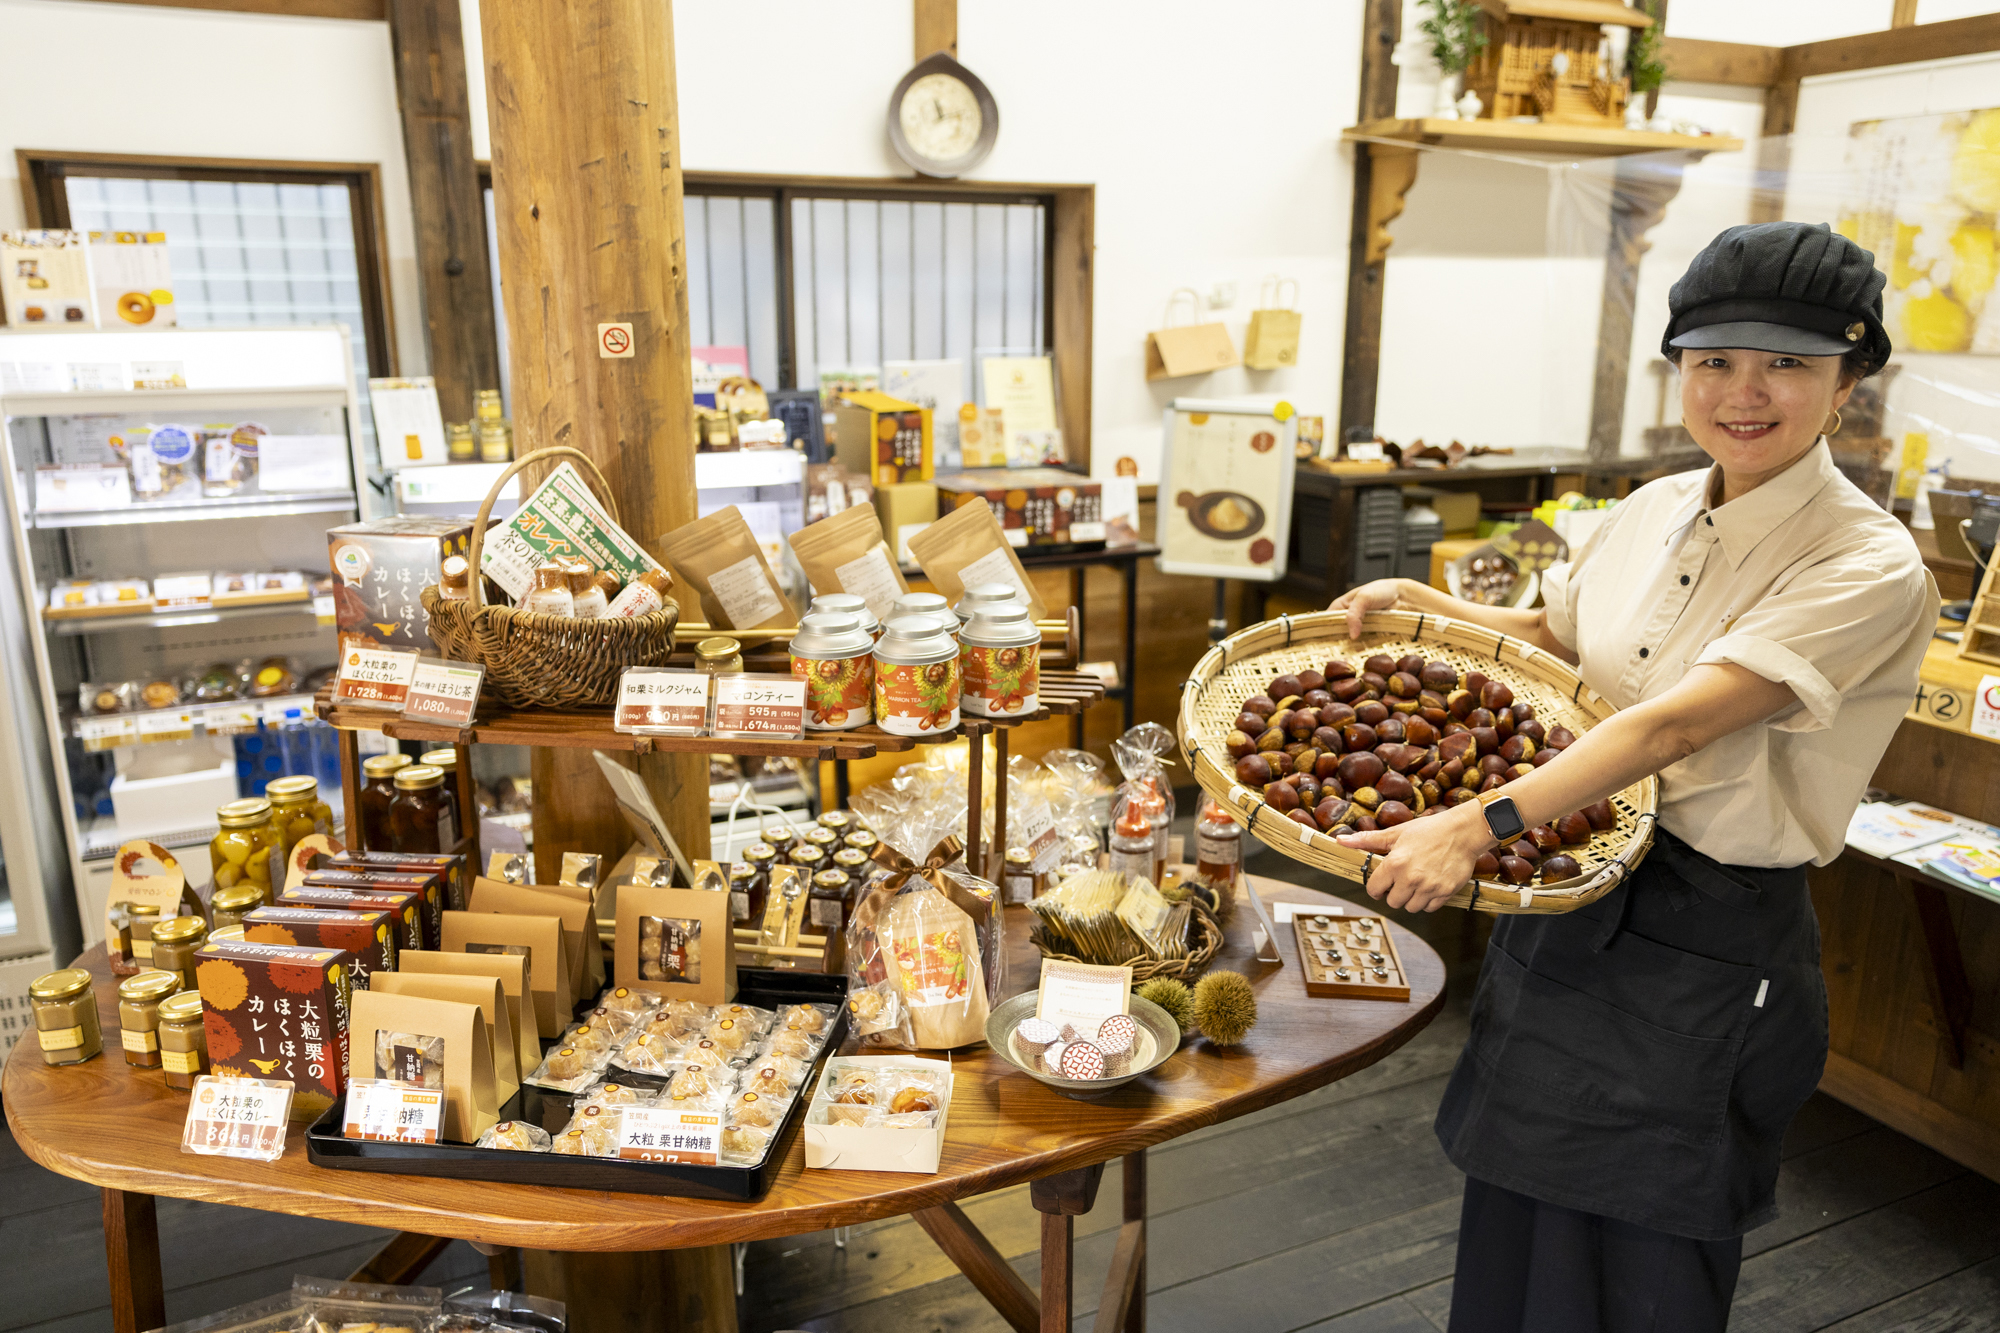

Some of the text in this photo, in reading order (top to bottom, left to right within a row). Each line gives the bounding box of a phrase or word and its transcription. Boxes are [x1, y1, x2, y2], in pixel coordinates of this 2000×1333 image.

[374, 566, 390, 618] カレー
[397, 568, 414, 638] ほくほく
[362, 659, 397, 671] 大粒栗の
[352, 670, 404, 681] ほくほくカレー
[438, 683, 472, 698] ほうじ茶
[626, 684, 702, 695] 和栗ミルクジャム
[731, 691, 794, 702] マロンティー
[413, 698, 450, 714] 1,080円
[749, 707, 777, 717] 595円
[646, 711, 679, 722] 90円
[739, 720, 776, 730] 1,674円
[666, 954, 680, 969] 栗
[248, 995, 268, 1054] カレー
[274, 998, 296, 1078] ほくほく
[299, 1000, 325, 1079] 大粒栗の
[219, 1095, 264, 1109] 大粒栗の
[206, 1107, 273, 1121] ほくほくカレー
[628, 1112, 649, 1120] 笠間産
[206, 1126, 250, 1145] 864円
[628, 1132, 711, 1150] 大粒 栗甘納糖
